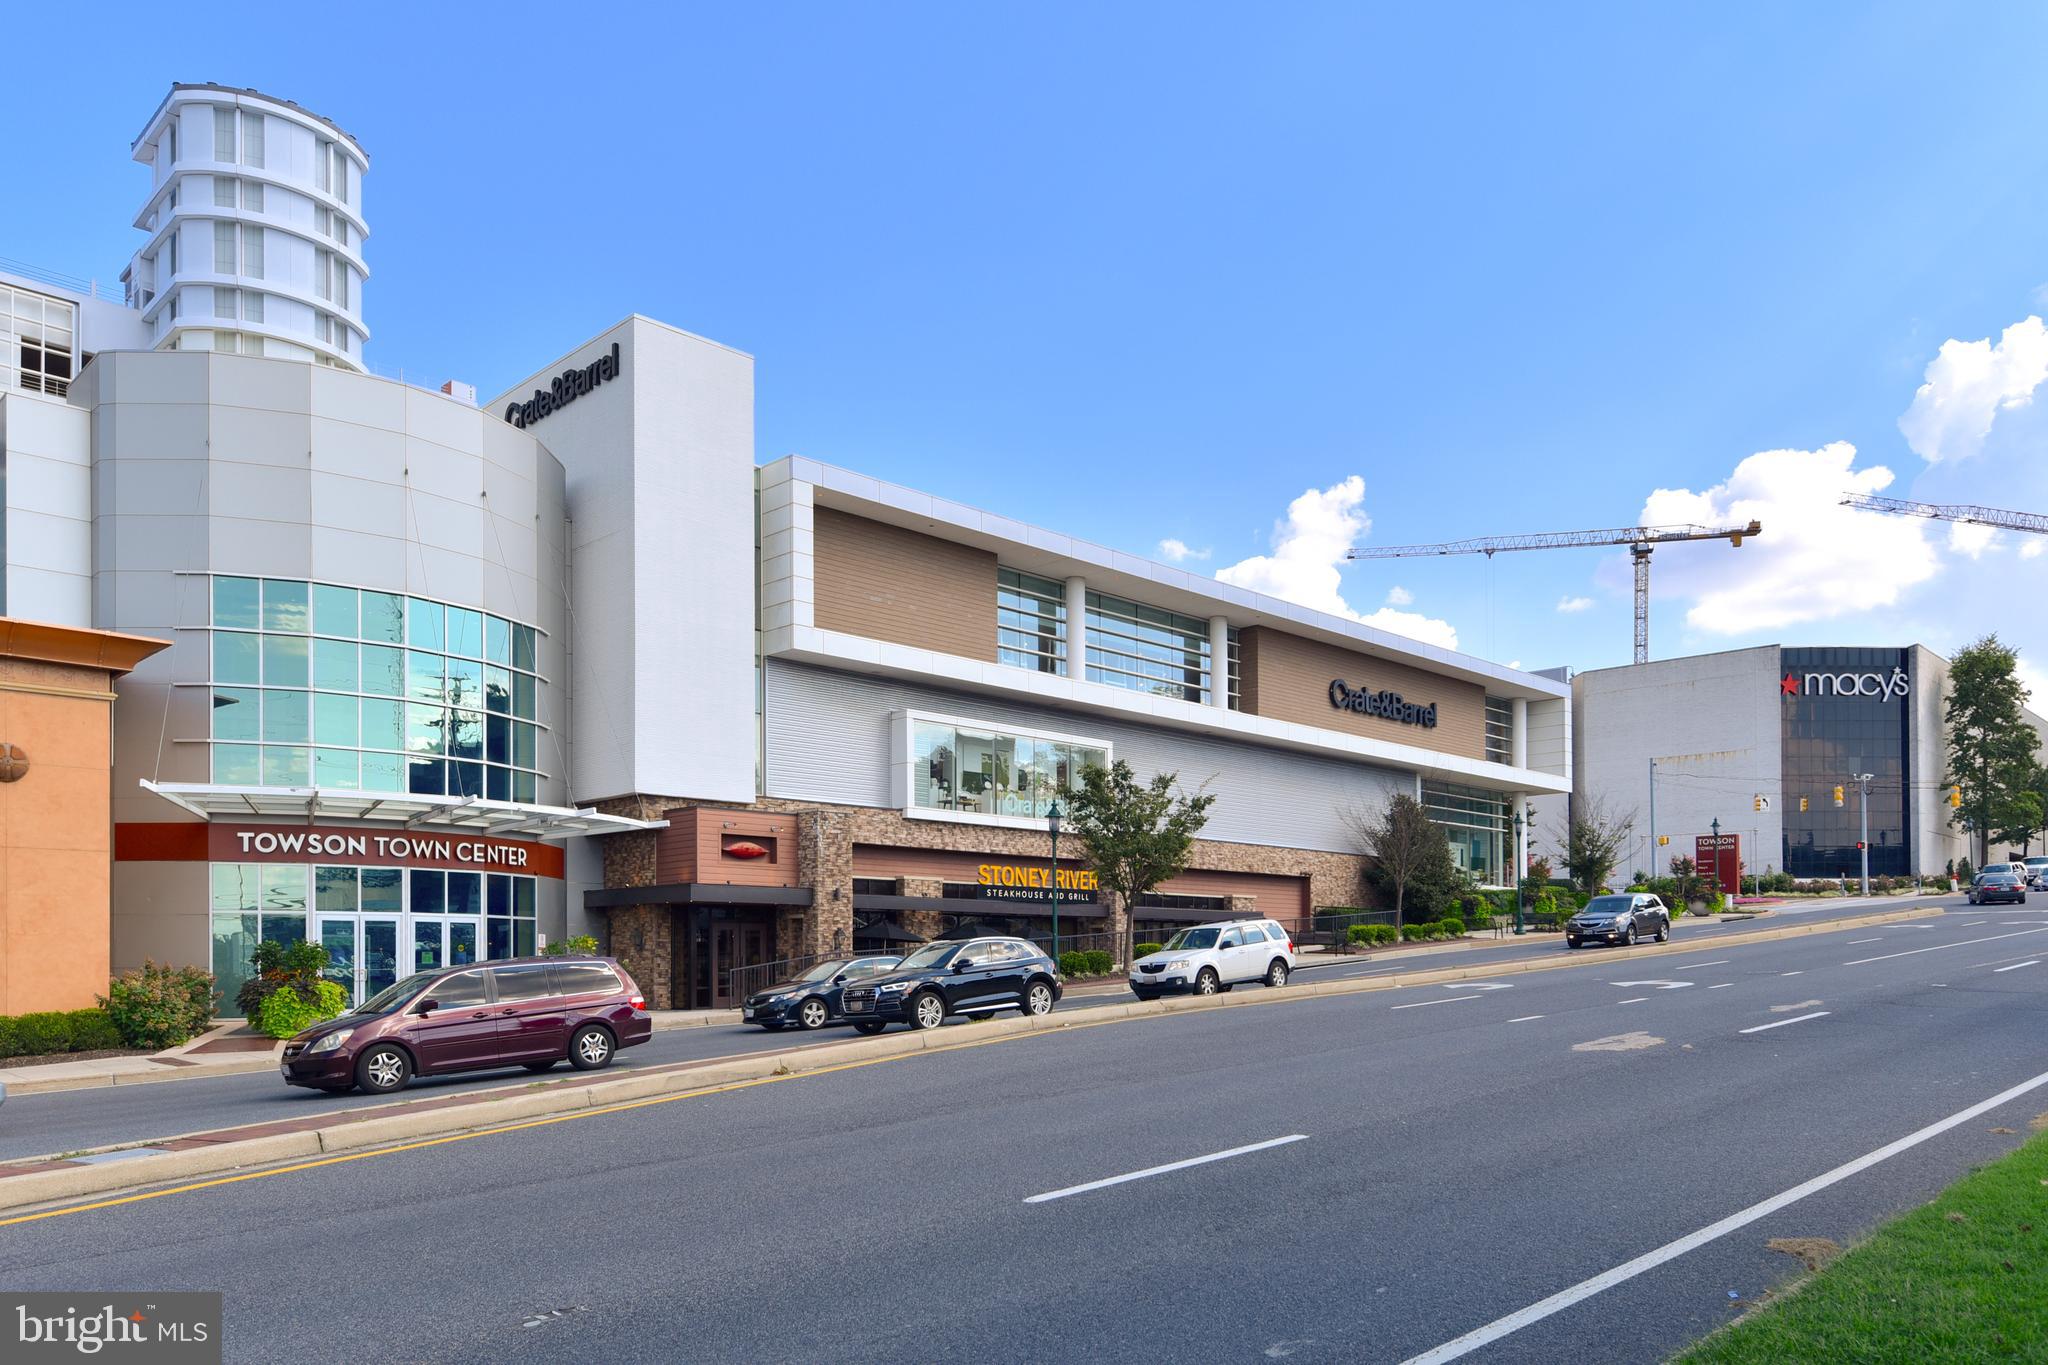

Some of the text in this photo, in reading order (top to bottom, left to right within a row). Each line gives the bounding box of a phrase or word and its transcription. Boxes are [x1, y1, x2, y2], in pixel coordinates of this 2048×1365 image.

[505, 342, 619, 428] Crate&Barrel
[1329, 679, 1437, 728] Crate&Barrel
[237, 832, 527, 866] TOWSON TOWN CENTER
[1698, 837, 1735, 845] TOWSON
[977, 864, 1098, 890] STONEY RIVER
[986, 889, 1044, 899] STEAKHOUSE
